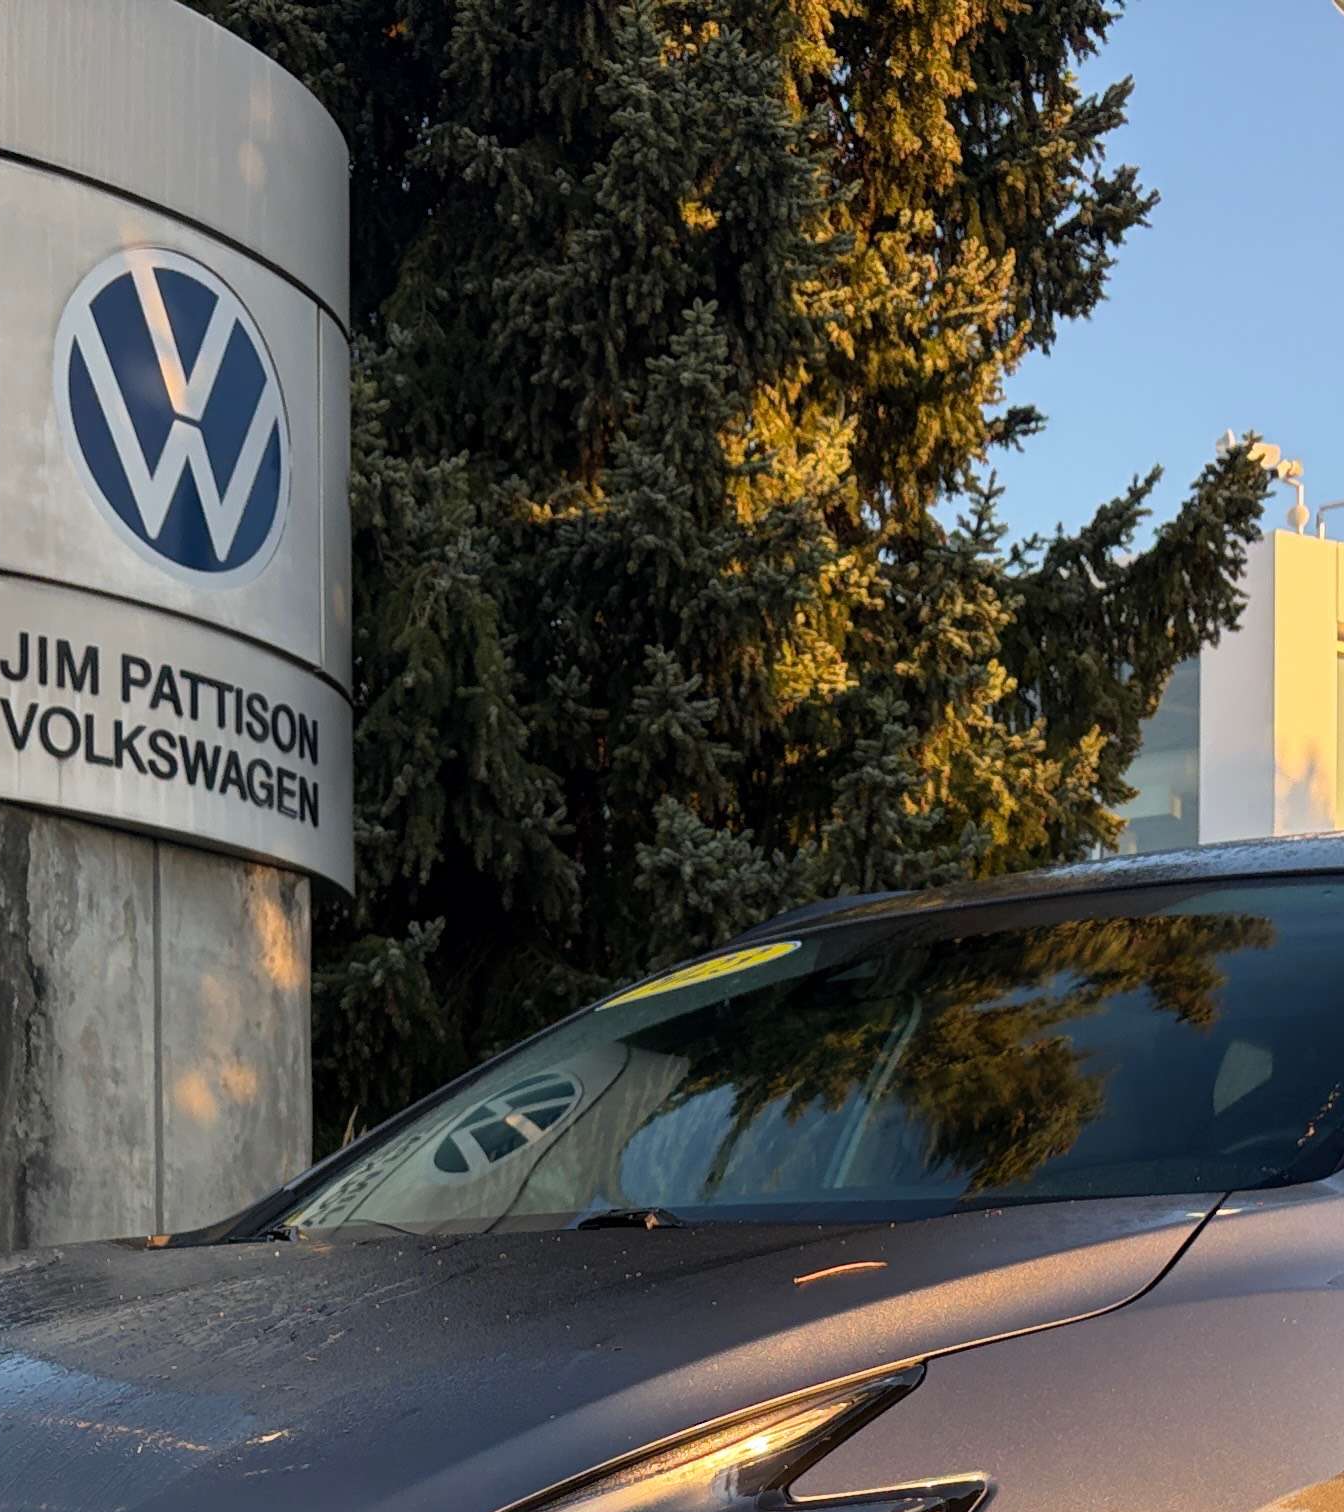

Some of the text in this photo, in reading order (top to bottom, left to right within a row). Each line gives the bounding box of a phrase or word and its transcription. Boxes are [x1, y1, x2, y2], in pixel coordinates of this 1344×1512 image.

[0, 632, 318, 766] JIM PATTISON
[0, 697, 319, 828] VOLKSWAGEN
